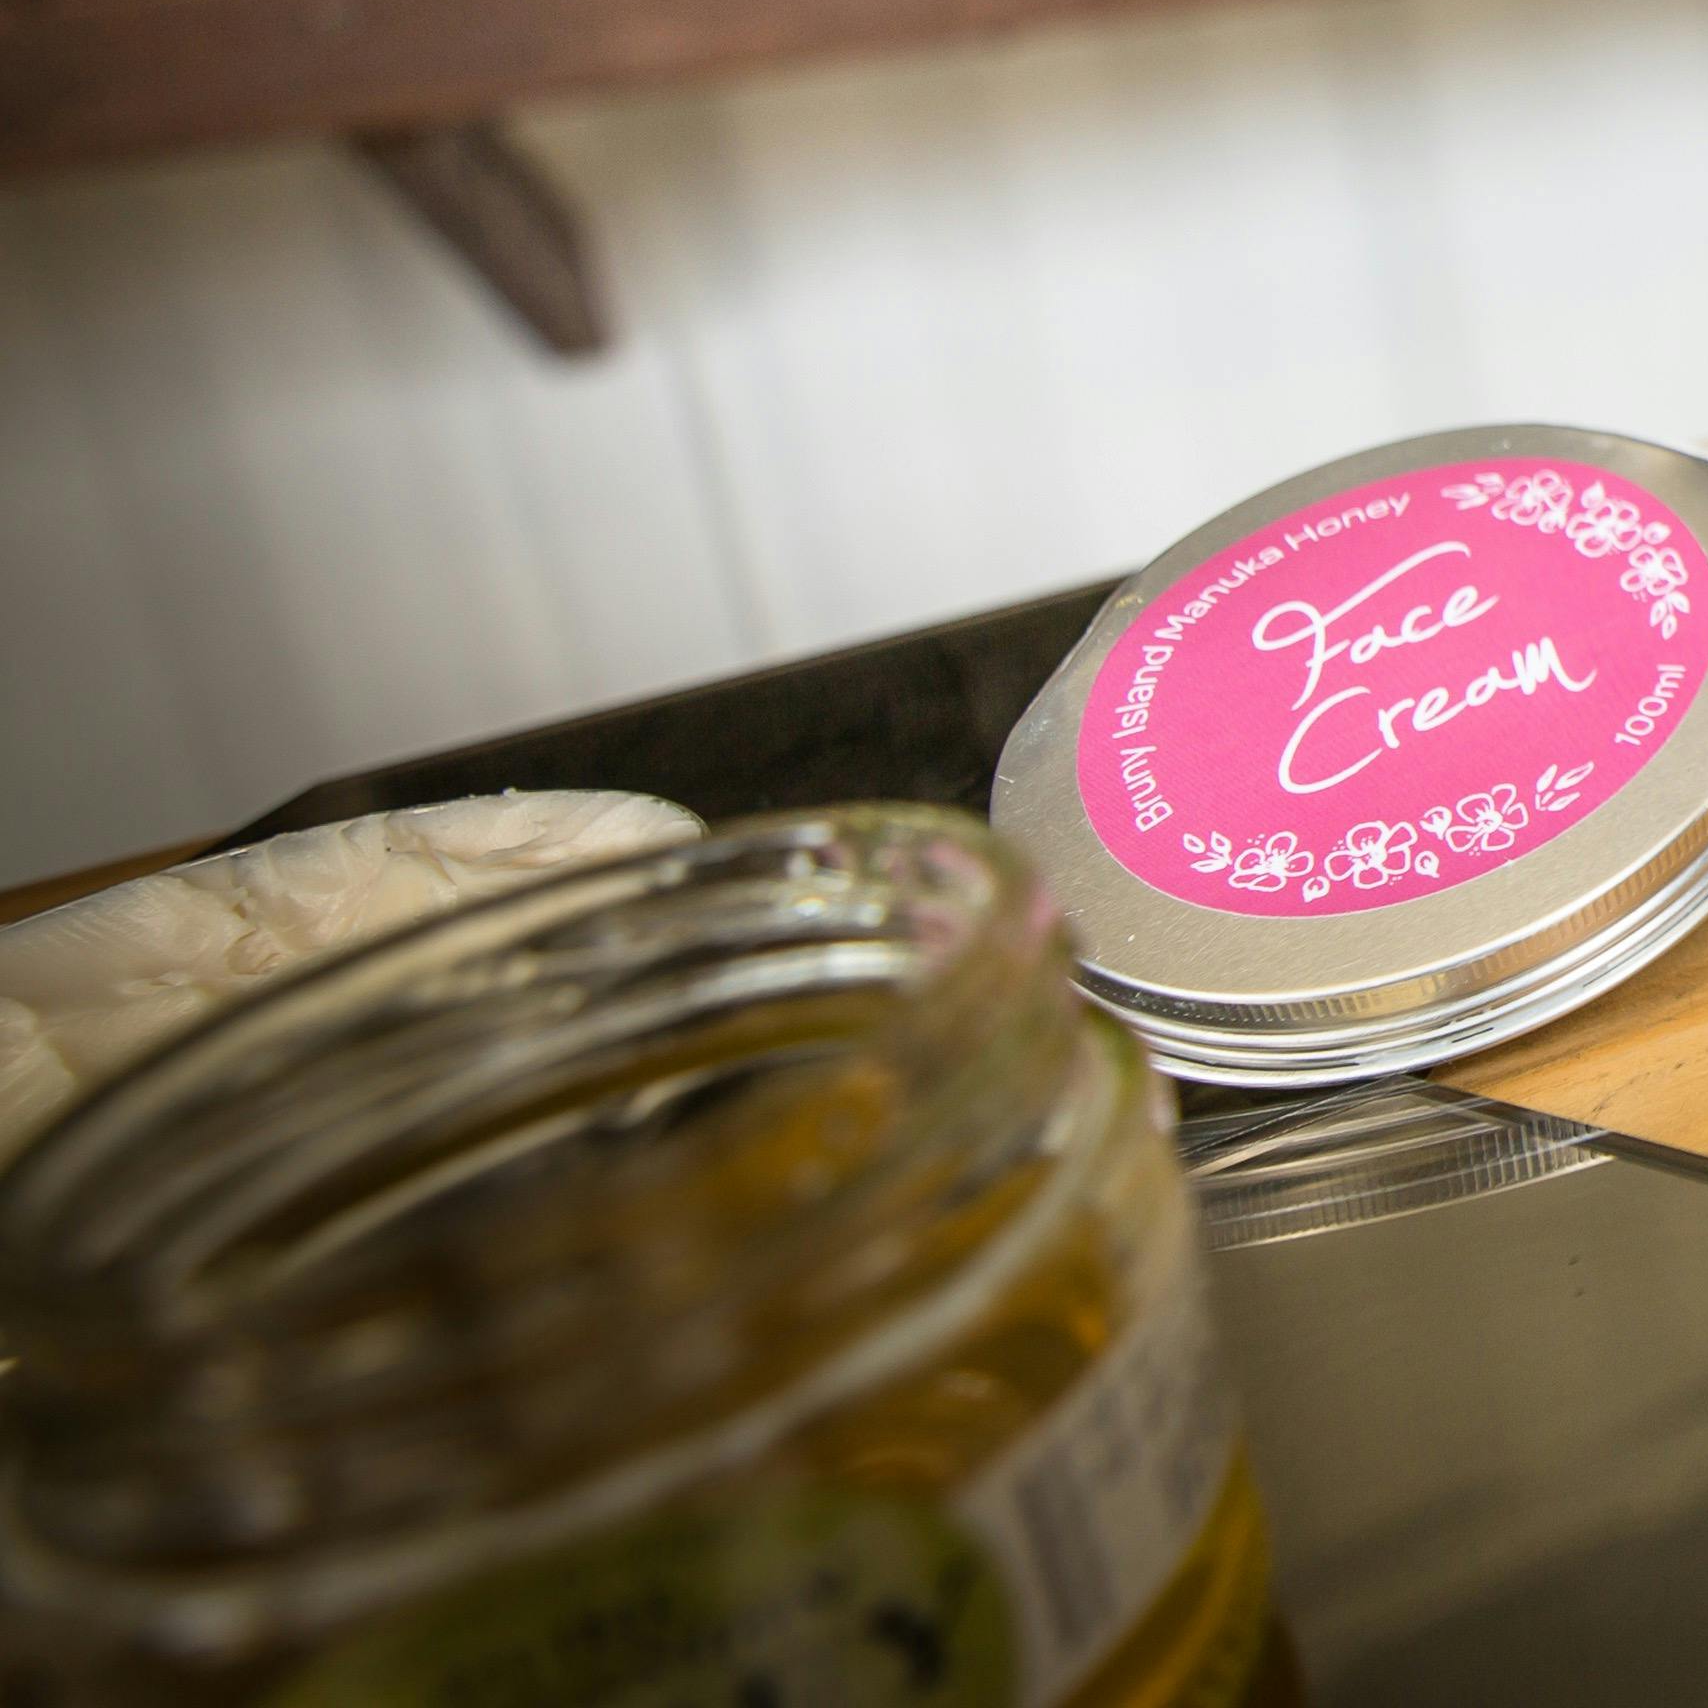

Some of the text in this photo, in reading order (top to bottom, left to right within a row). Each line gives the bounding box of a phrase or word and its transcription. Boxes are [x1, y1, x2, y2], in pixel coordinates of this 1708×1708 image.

[1112, 491, 1411, 832] Bruny Island Manuka Honey
[1251, 541, 1501, 711] Face
[1614, 664, 1687, 746] 100ml
[1278, 636, 1598, 795] Cream
